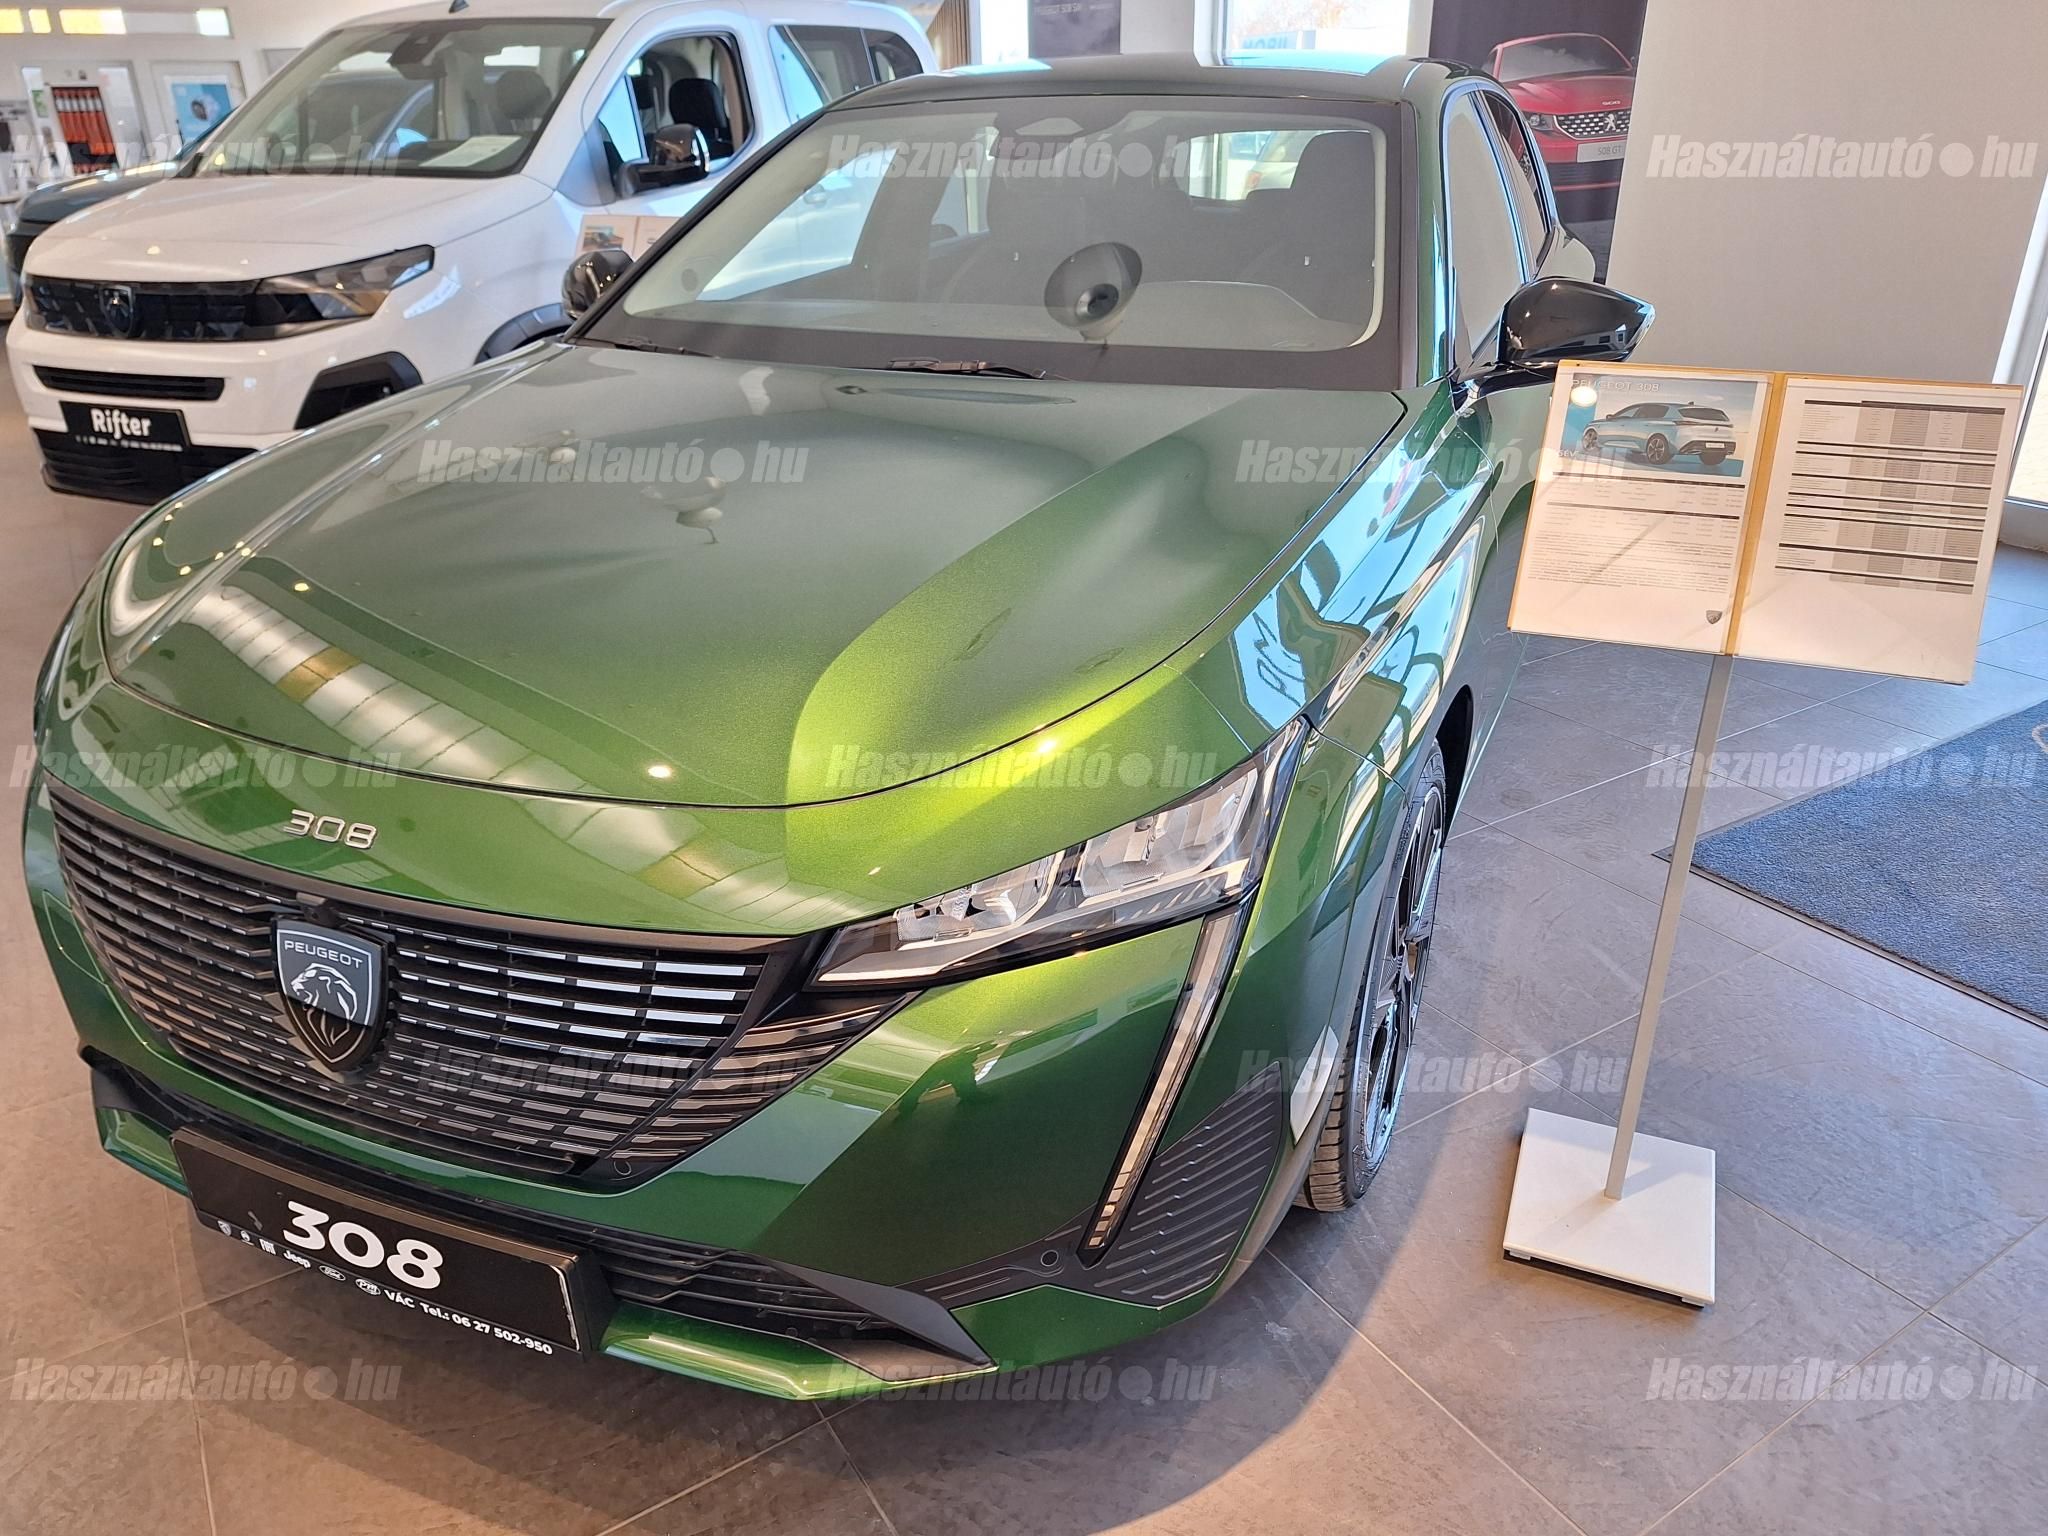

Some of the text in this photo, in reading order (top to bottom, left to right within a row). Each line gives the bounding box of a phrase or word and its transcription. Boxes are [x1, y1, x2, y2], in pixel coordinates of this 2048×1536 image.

[1637, 382, 1660, 392] 308
[90, 408, 152, 439] Rifter
[283, 808, 377, 849] 308
[284, 940, 364, 969] PEUGEOT
[283, 1200, 443, 1290] 308
[283, 1250, 312, 1269] Jeep
[383, 1289, 416, 1309] VÁC
[419, 1301, 450, 1321] Tel.:
[451, 1313, 472, 1328] 06
[472, 1320, 491, 1335] 27
[493, 1327, 553, 1355] 502-950
